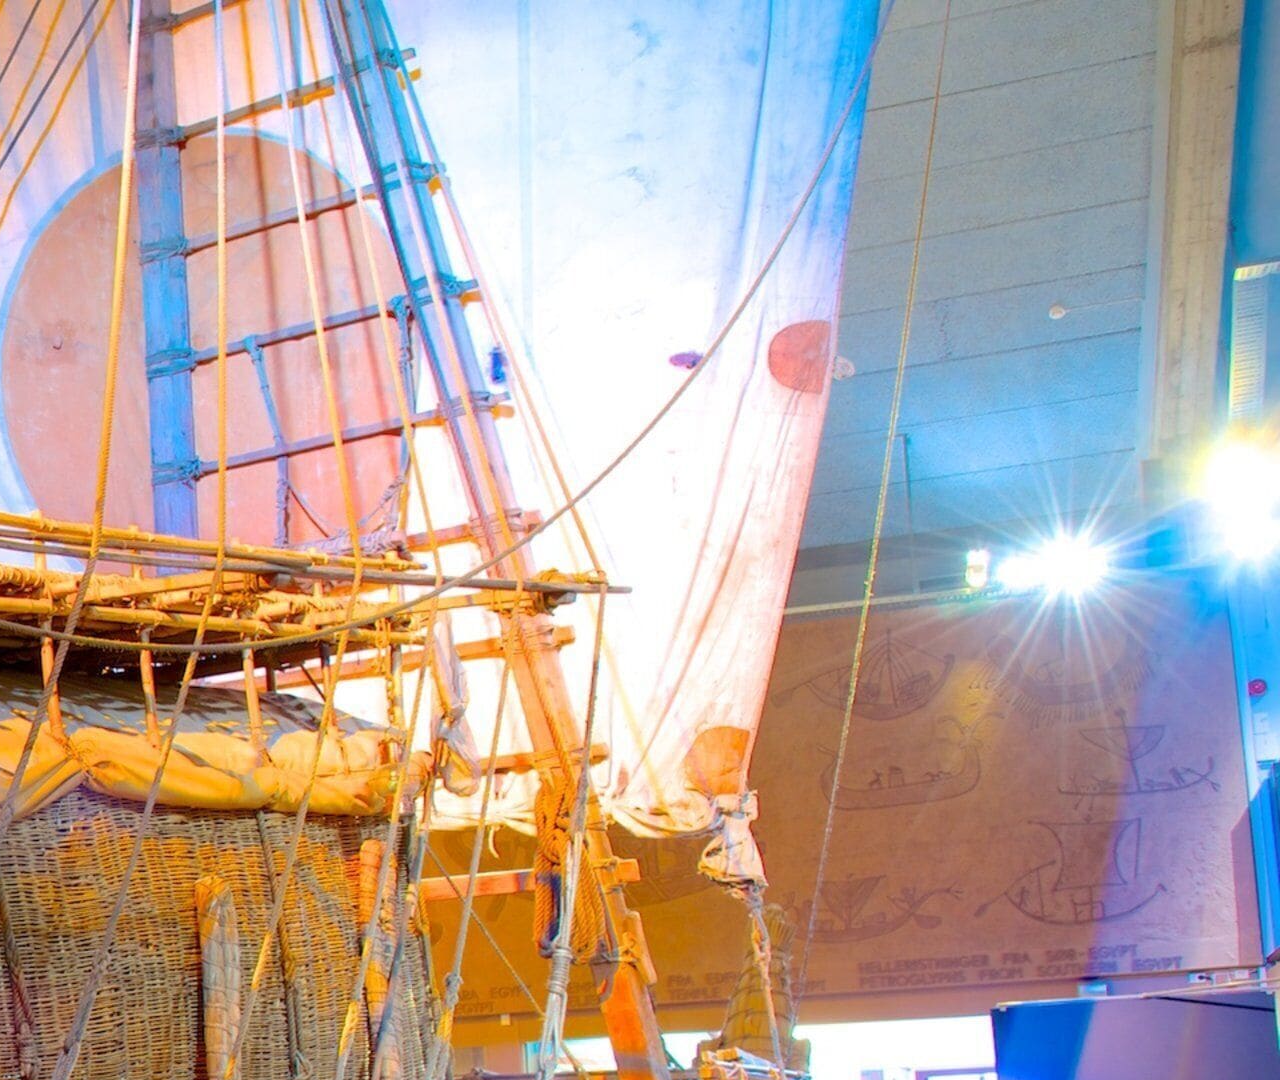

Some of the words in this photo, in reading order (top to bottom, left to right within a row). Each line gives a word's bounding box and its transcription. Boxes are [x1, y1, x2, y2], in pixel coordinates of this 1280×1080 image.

[978, 966, 1024, 981] FROM
[1132, 956, 1182, 972] EGYPT
[1002, 951, 1031, 966] FRA
